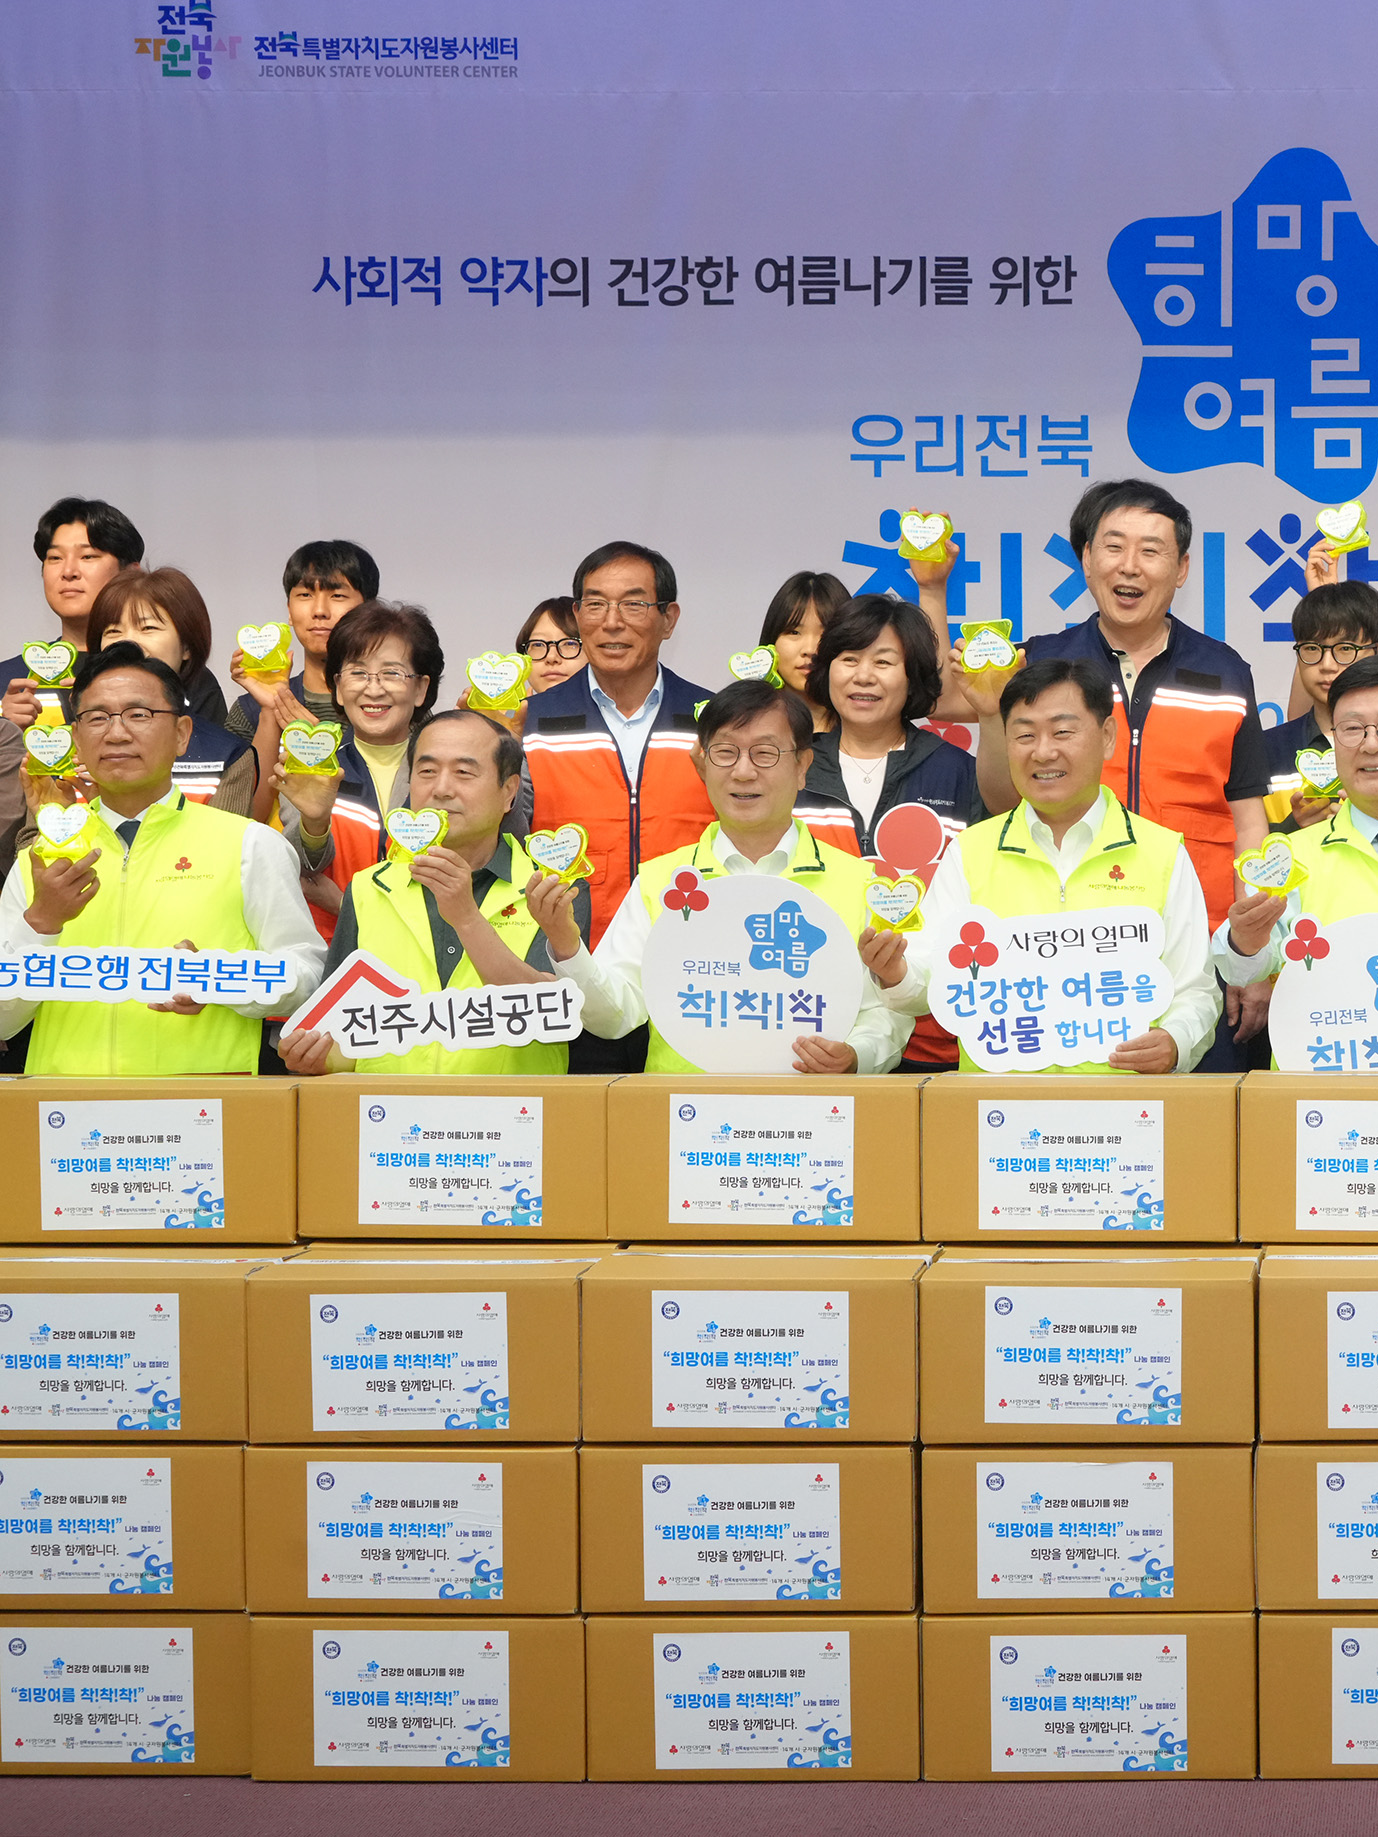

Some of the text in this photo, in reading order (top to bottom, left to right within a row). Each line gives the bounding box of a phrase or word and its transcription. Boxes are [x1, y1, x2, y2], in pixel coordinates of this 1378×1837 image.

[258, 64, 518, 78] JEONBUK STATE VOLUNTEER CENTER
[311, 256, 1078, 307] 사회적 약자의 건강한 여름나기를 위한
[849, 414, 1094, 477] 우리전북
[753, 910, 805, 950] 희망
[762, 944, 810, 973] 여름
[138, 955, 287, 994] 전북본부
[682, 959, 741, 977] 우리전북
[946, 970, 1157, 1017] 건강한 여름을
[677, 983, 826, 1033] 착!착!착
[341, 989, 573, 1047] 전주시설공단
[1309, 1007, 1368, 1026] 우리전북
[977, 1016, 1131, 1054] 선물 합니다
[103, 1135, 181, 1144] 건강한 여름나기를 위한
[423, 1131, 444, 1139] 건강한
[487, 1132, 501, 1140] 위한
[91, 1182, 173, 1194] 희망을 함께합니다.
[409, 1178, 492, 1189] 희망을 함께합니다.
[1053, 1325, 1137, 1333] 건강한 여름나기를 위한
[1039, 1374, 1127, 1386] 희망을 함께합니다.
[711, 1501, 795, 1510] 건강한 여름나기를 위한
[698, 1550, 786, 1562] 희망을 함께합니다.
[722, 1669, 805, 1678] 건강한 여름나기를 위한
[709, 1719, 797, 1731] 희망을 함께합니다.
